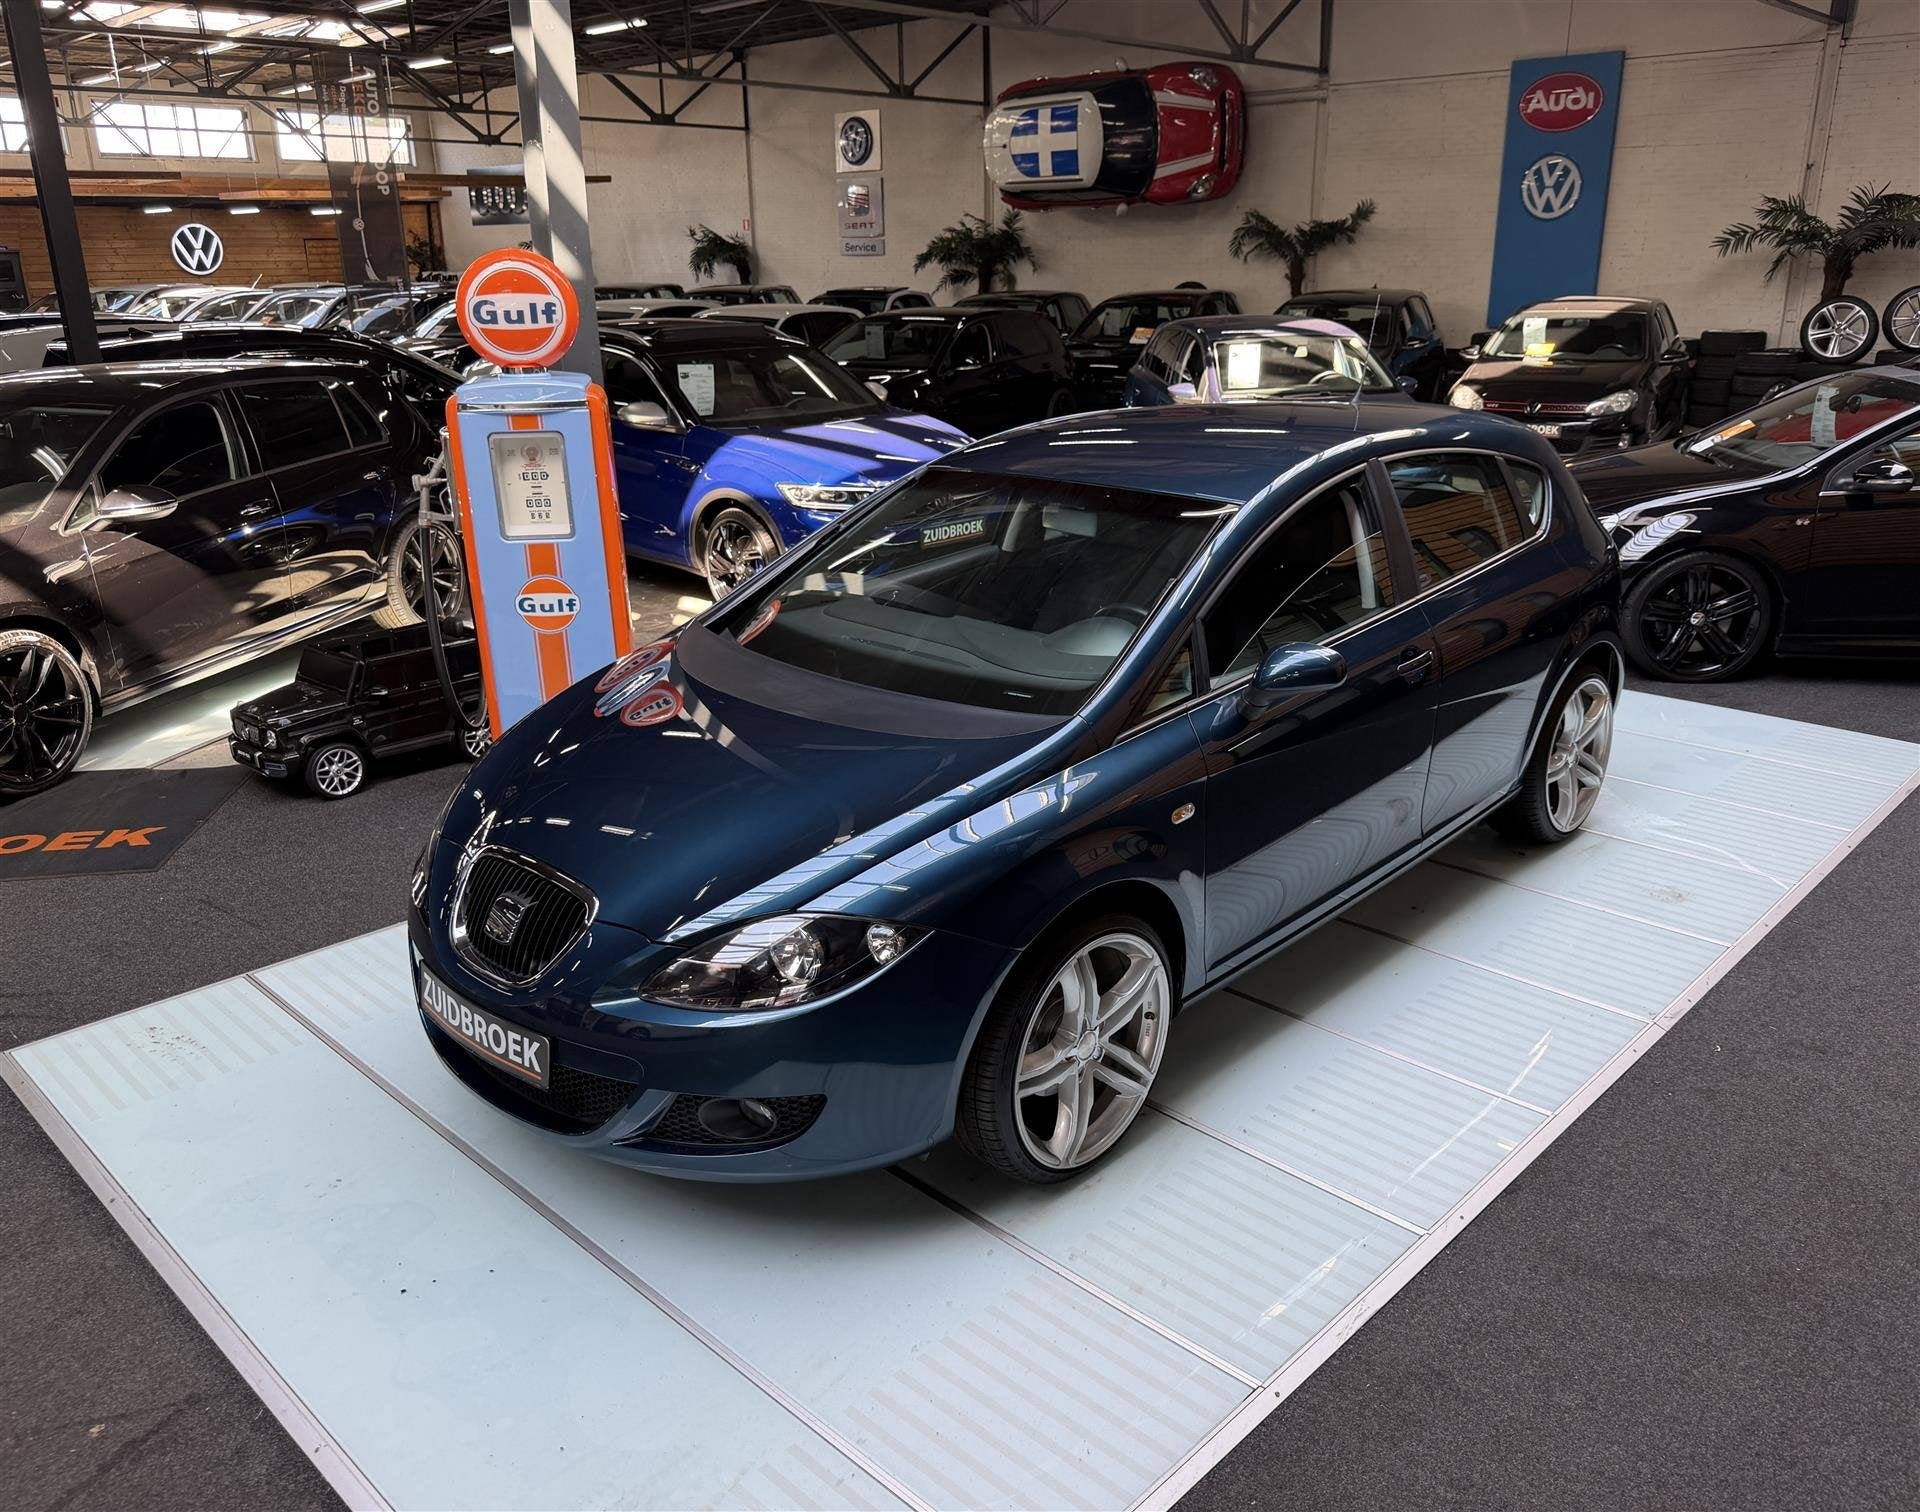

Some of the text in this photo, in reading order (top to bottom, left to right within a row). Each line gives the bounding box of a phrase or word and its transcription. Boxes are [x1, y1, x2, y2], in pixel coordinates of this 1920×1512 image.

[844, 222, 875, 230] SEAT
[844, 241, 878, 253] Service
[473, 300, 556, 325] Gulf
[923, 519, 983, 543] ZUIDBROEK
[518, 597, 577, 613] Gulf
[423, 972, 542, 1073] ZUIDBROEK
